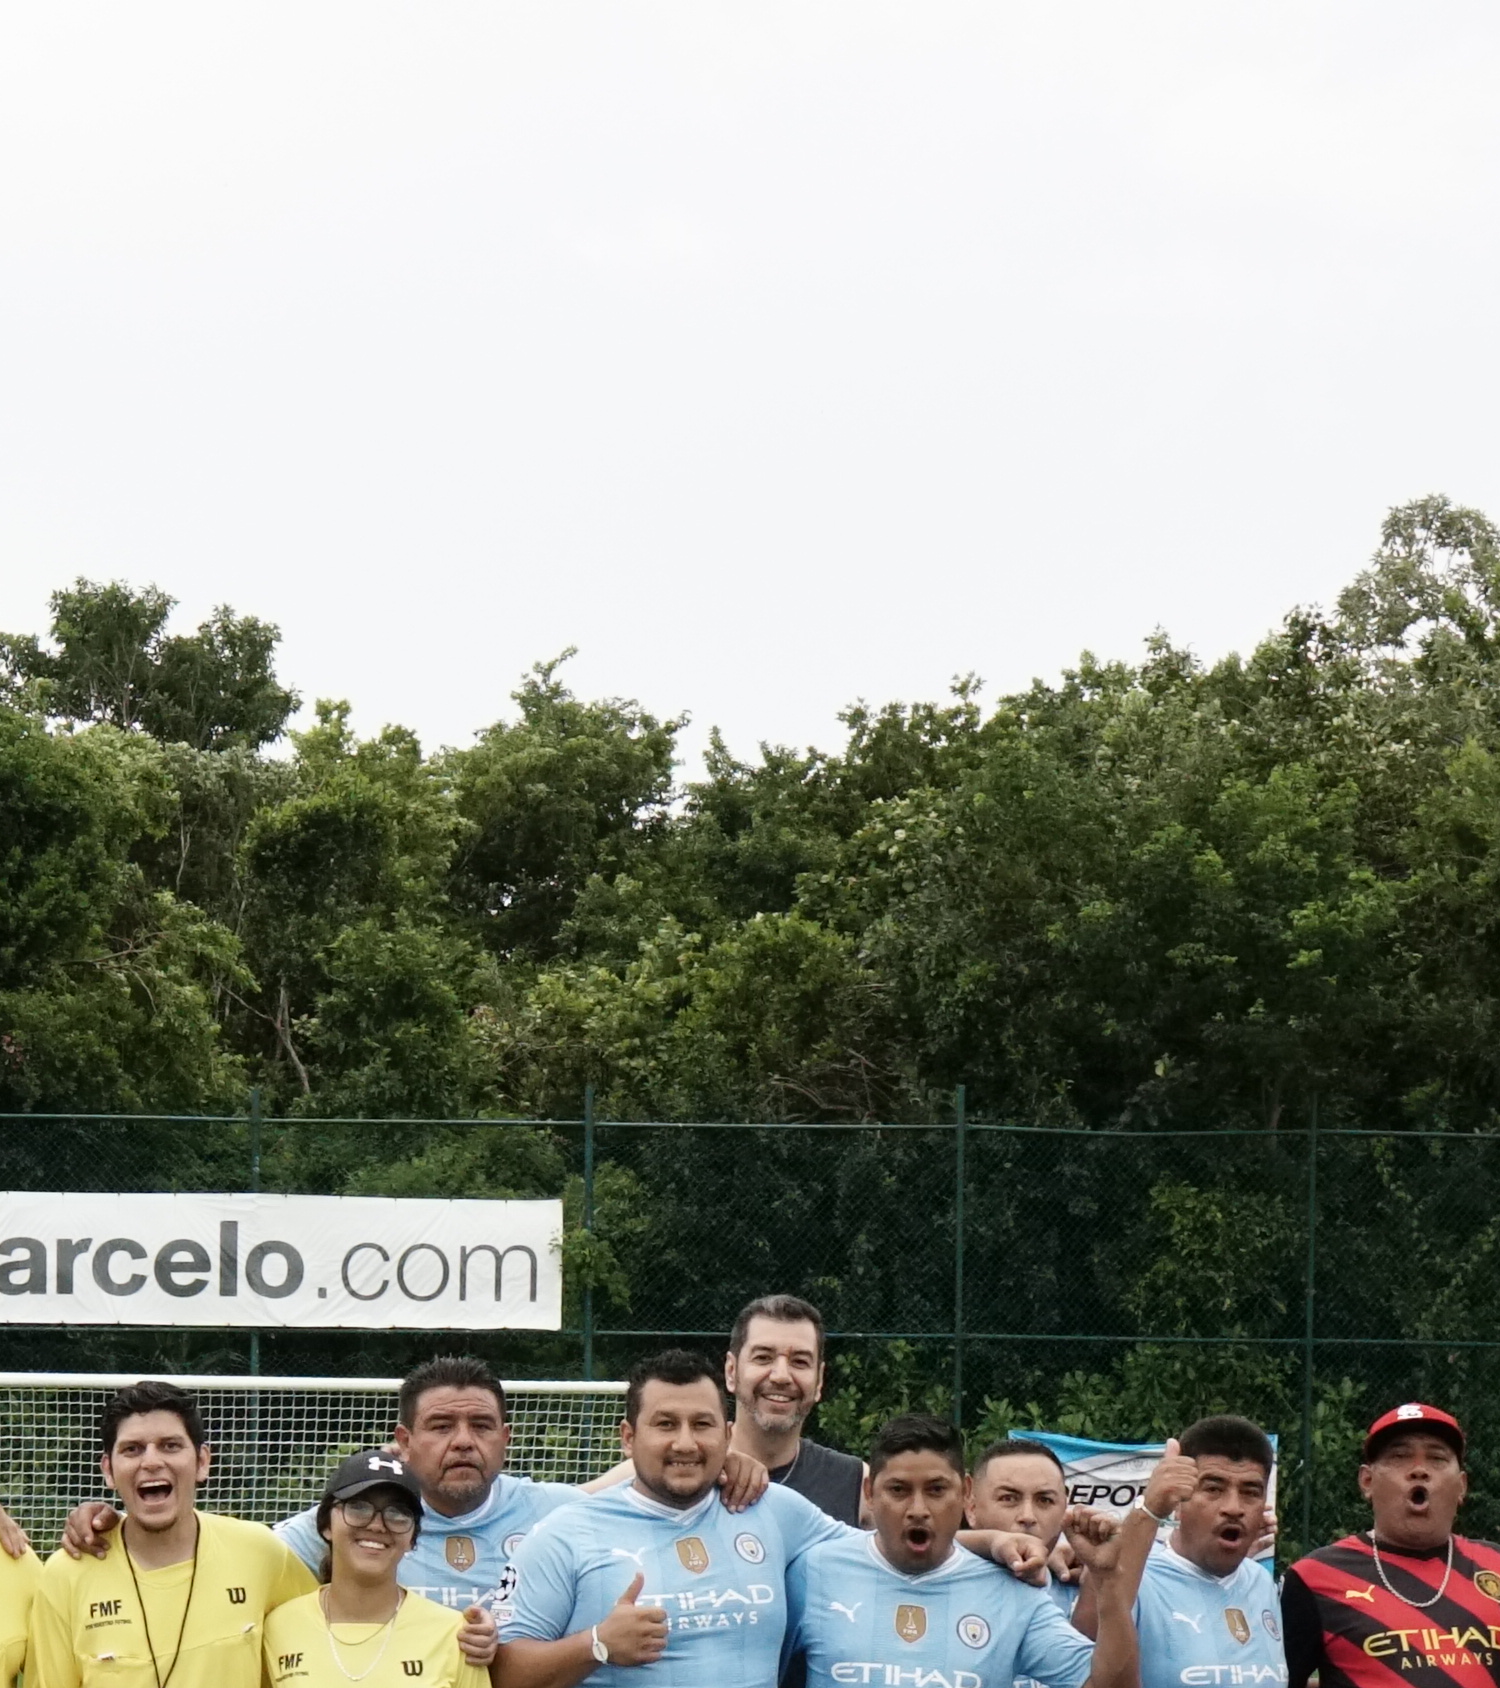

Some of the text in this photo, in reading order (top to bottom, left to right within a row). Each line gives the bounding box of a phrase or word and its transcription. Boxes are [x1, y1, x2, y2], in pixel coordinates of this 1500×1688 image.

[89, 1599, 122, 1619] FMF
[278, 1652, 304, 1673] FMF
[1400, 1652, 1494, 1670] AIRWAYS
